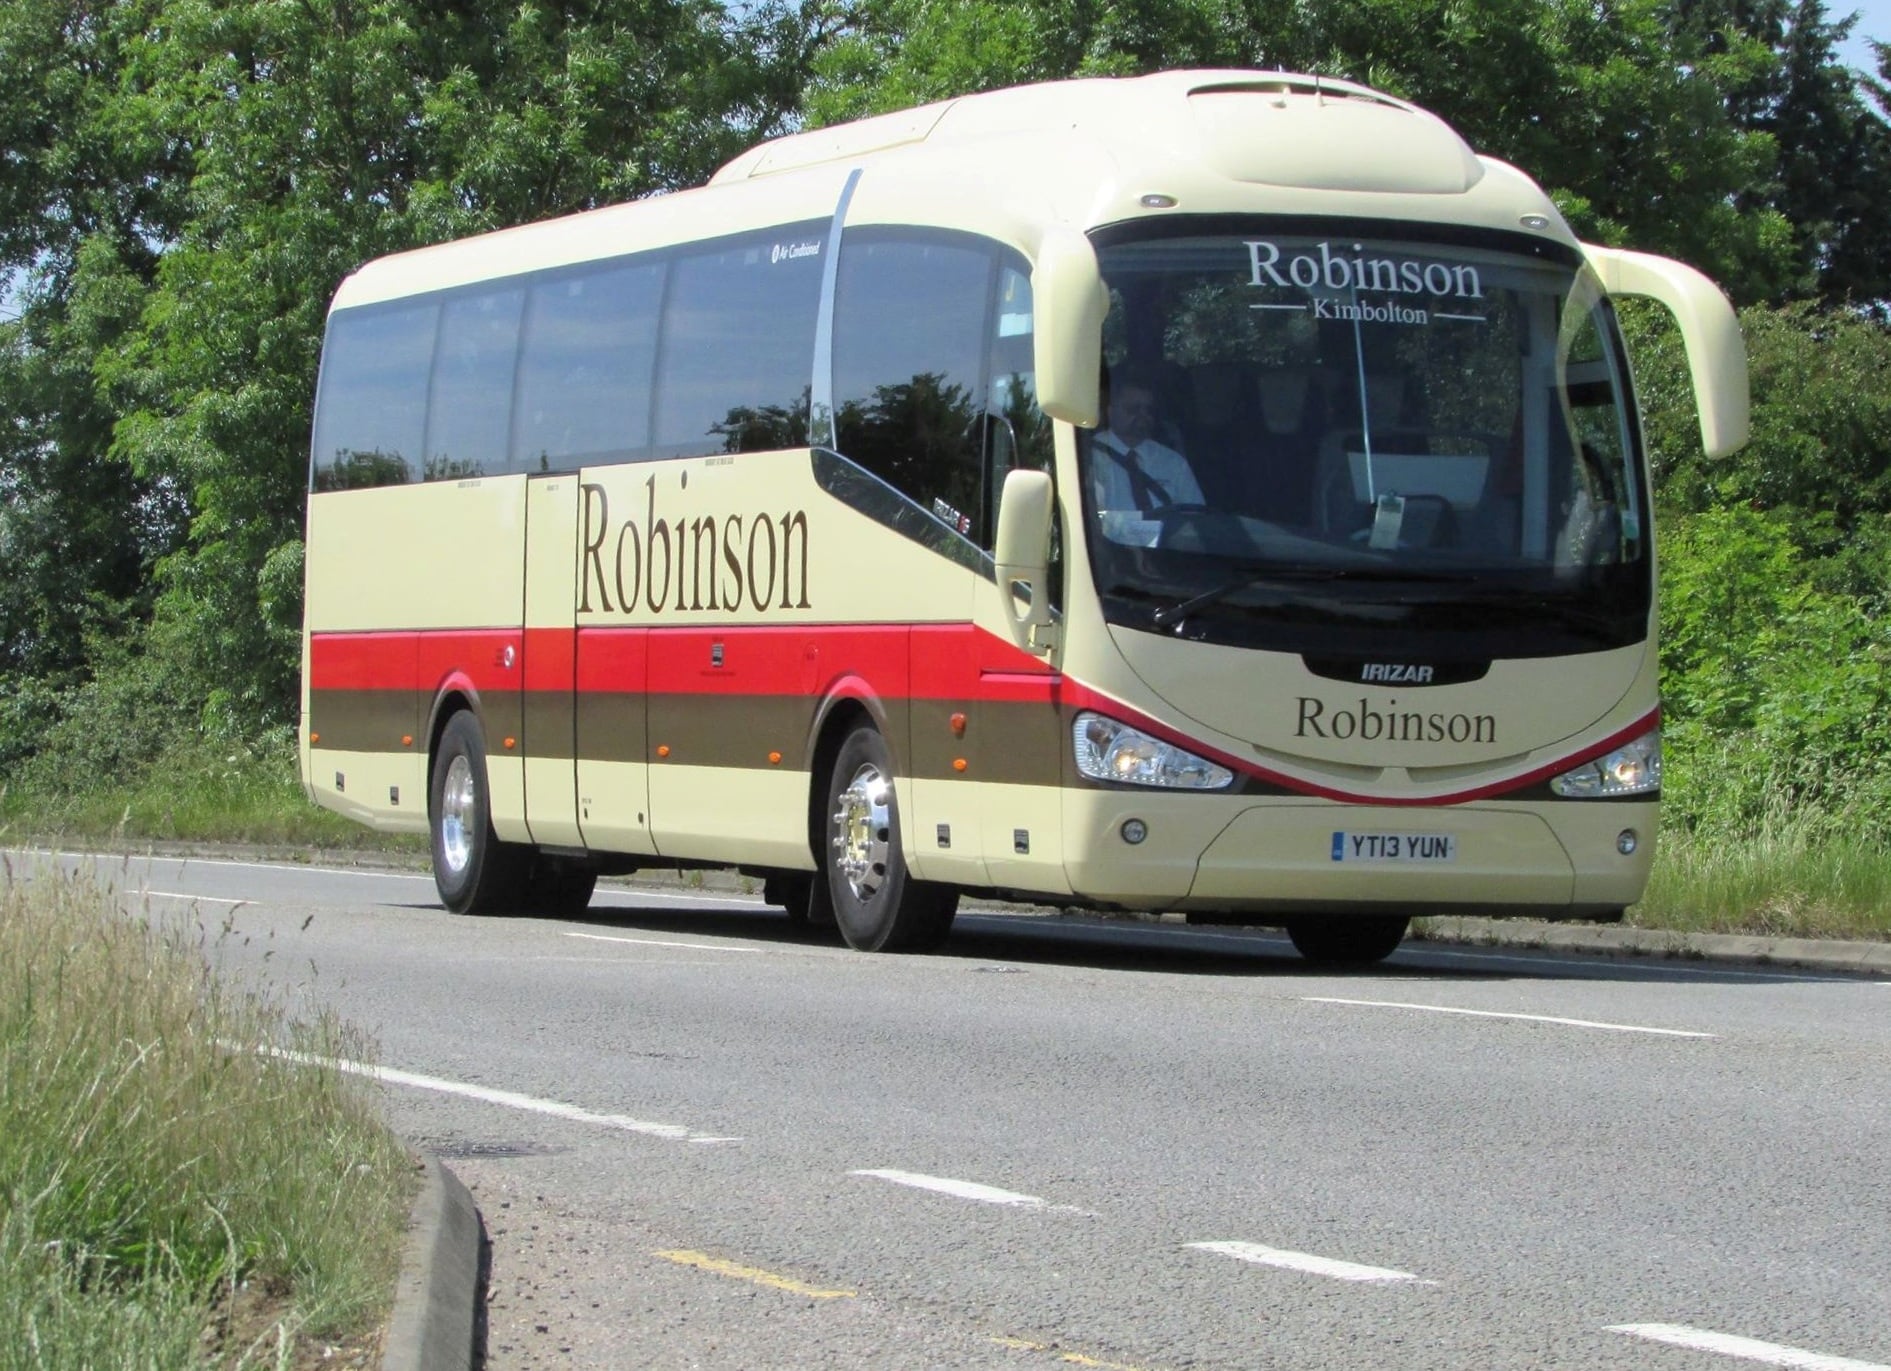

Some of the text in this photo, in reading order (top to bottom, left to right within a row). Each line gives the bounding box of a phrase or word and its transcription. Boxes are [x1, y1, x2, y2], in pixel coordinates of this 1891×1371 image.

[1243, 241, 1484, 299] Robinson
[1313, 298, 1428, 325] Kimbolton
[577, 469, 812, 614] Robinson
[1361, 663, 1434, 683] IRIZAR
[1293, 696, 1497, 744] Robinson
[1352, 835, 1448, 858] YT13 YUN
